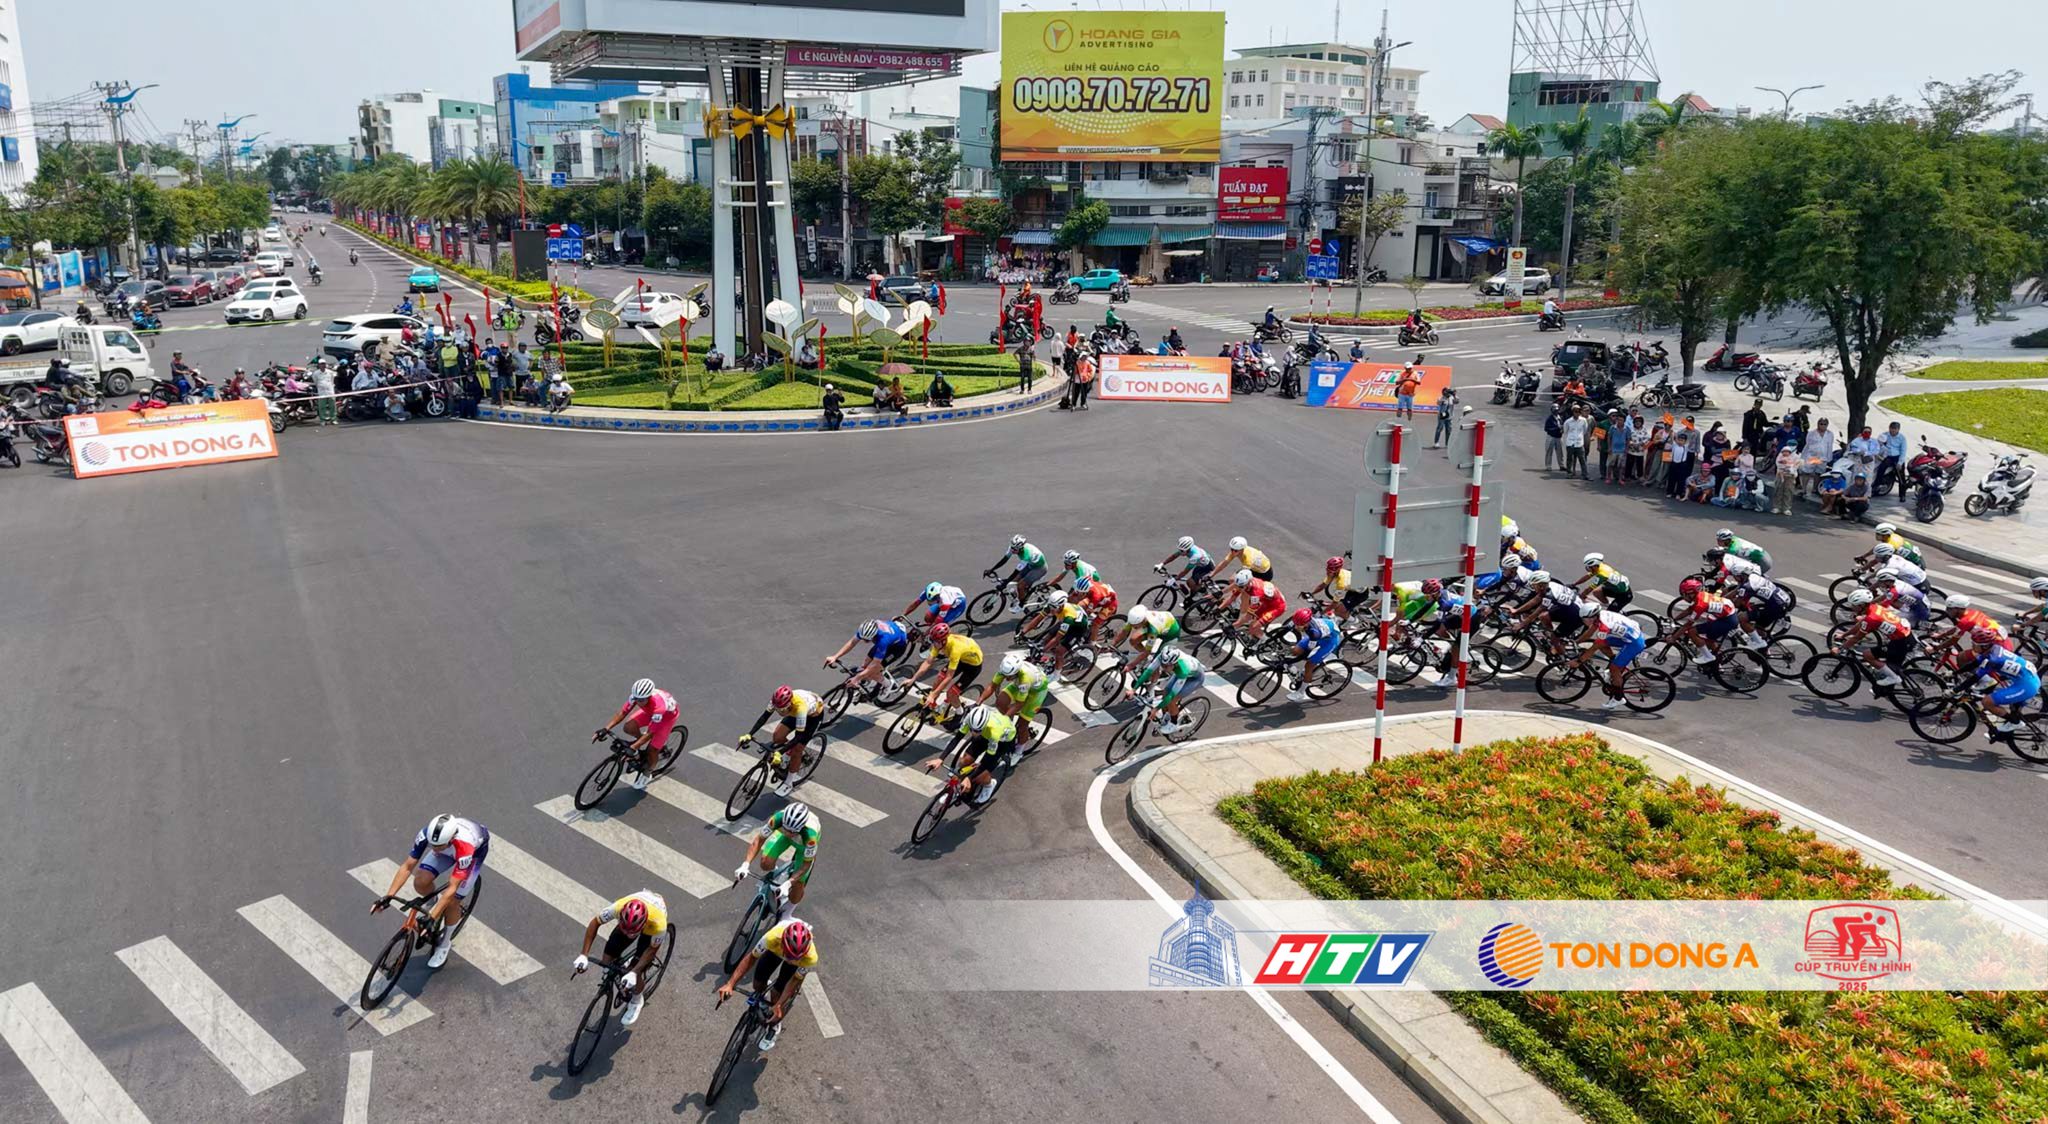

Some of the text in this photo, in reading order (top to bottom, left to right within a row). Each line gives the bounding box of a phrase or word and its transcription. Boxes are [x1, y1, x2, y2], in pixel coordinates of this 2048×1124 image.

[1151, 29, 1181, 40] GIA
[853, 54, 873, 64] ADV
[879, 54, 943, 67] 0982.488.655
[1014, 77, 1210, 112] 0908.70.72.71
[1223, 179, 1268, 195] TUẤN ĐẠT
[1125, 380, 1224, 395] TON DONG A
[113, 432, 266, 462] TON DONG A
[1614, 624, 1626, 636] 12
[2006, 661, 2018, 674] 74
